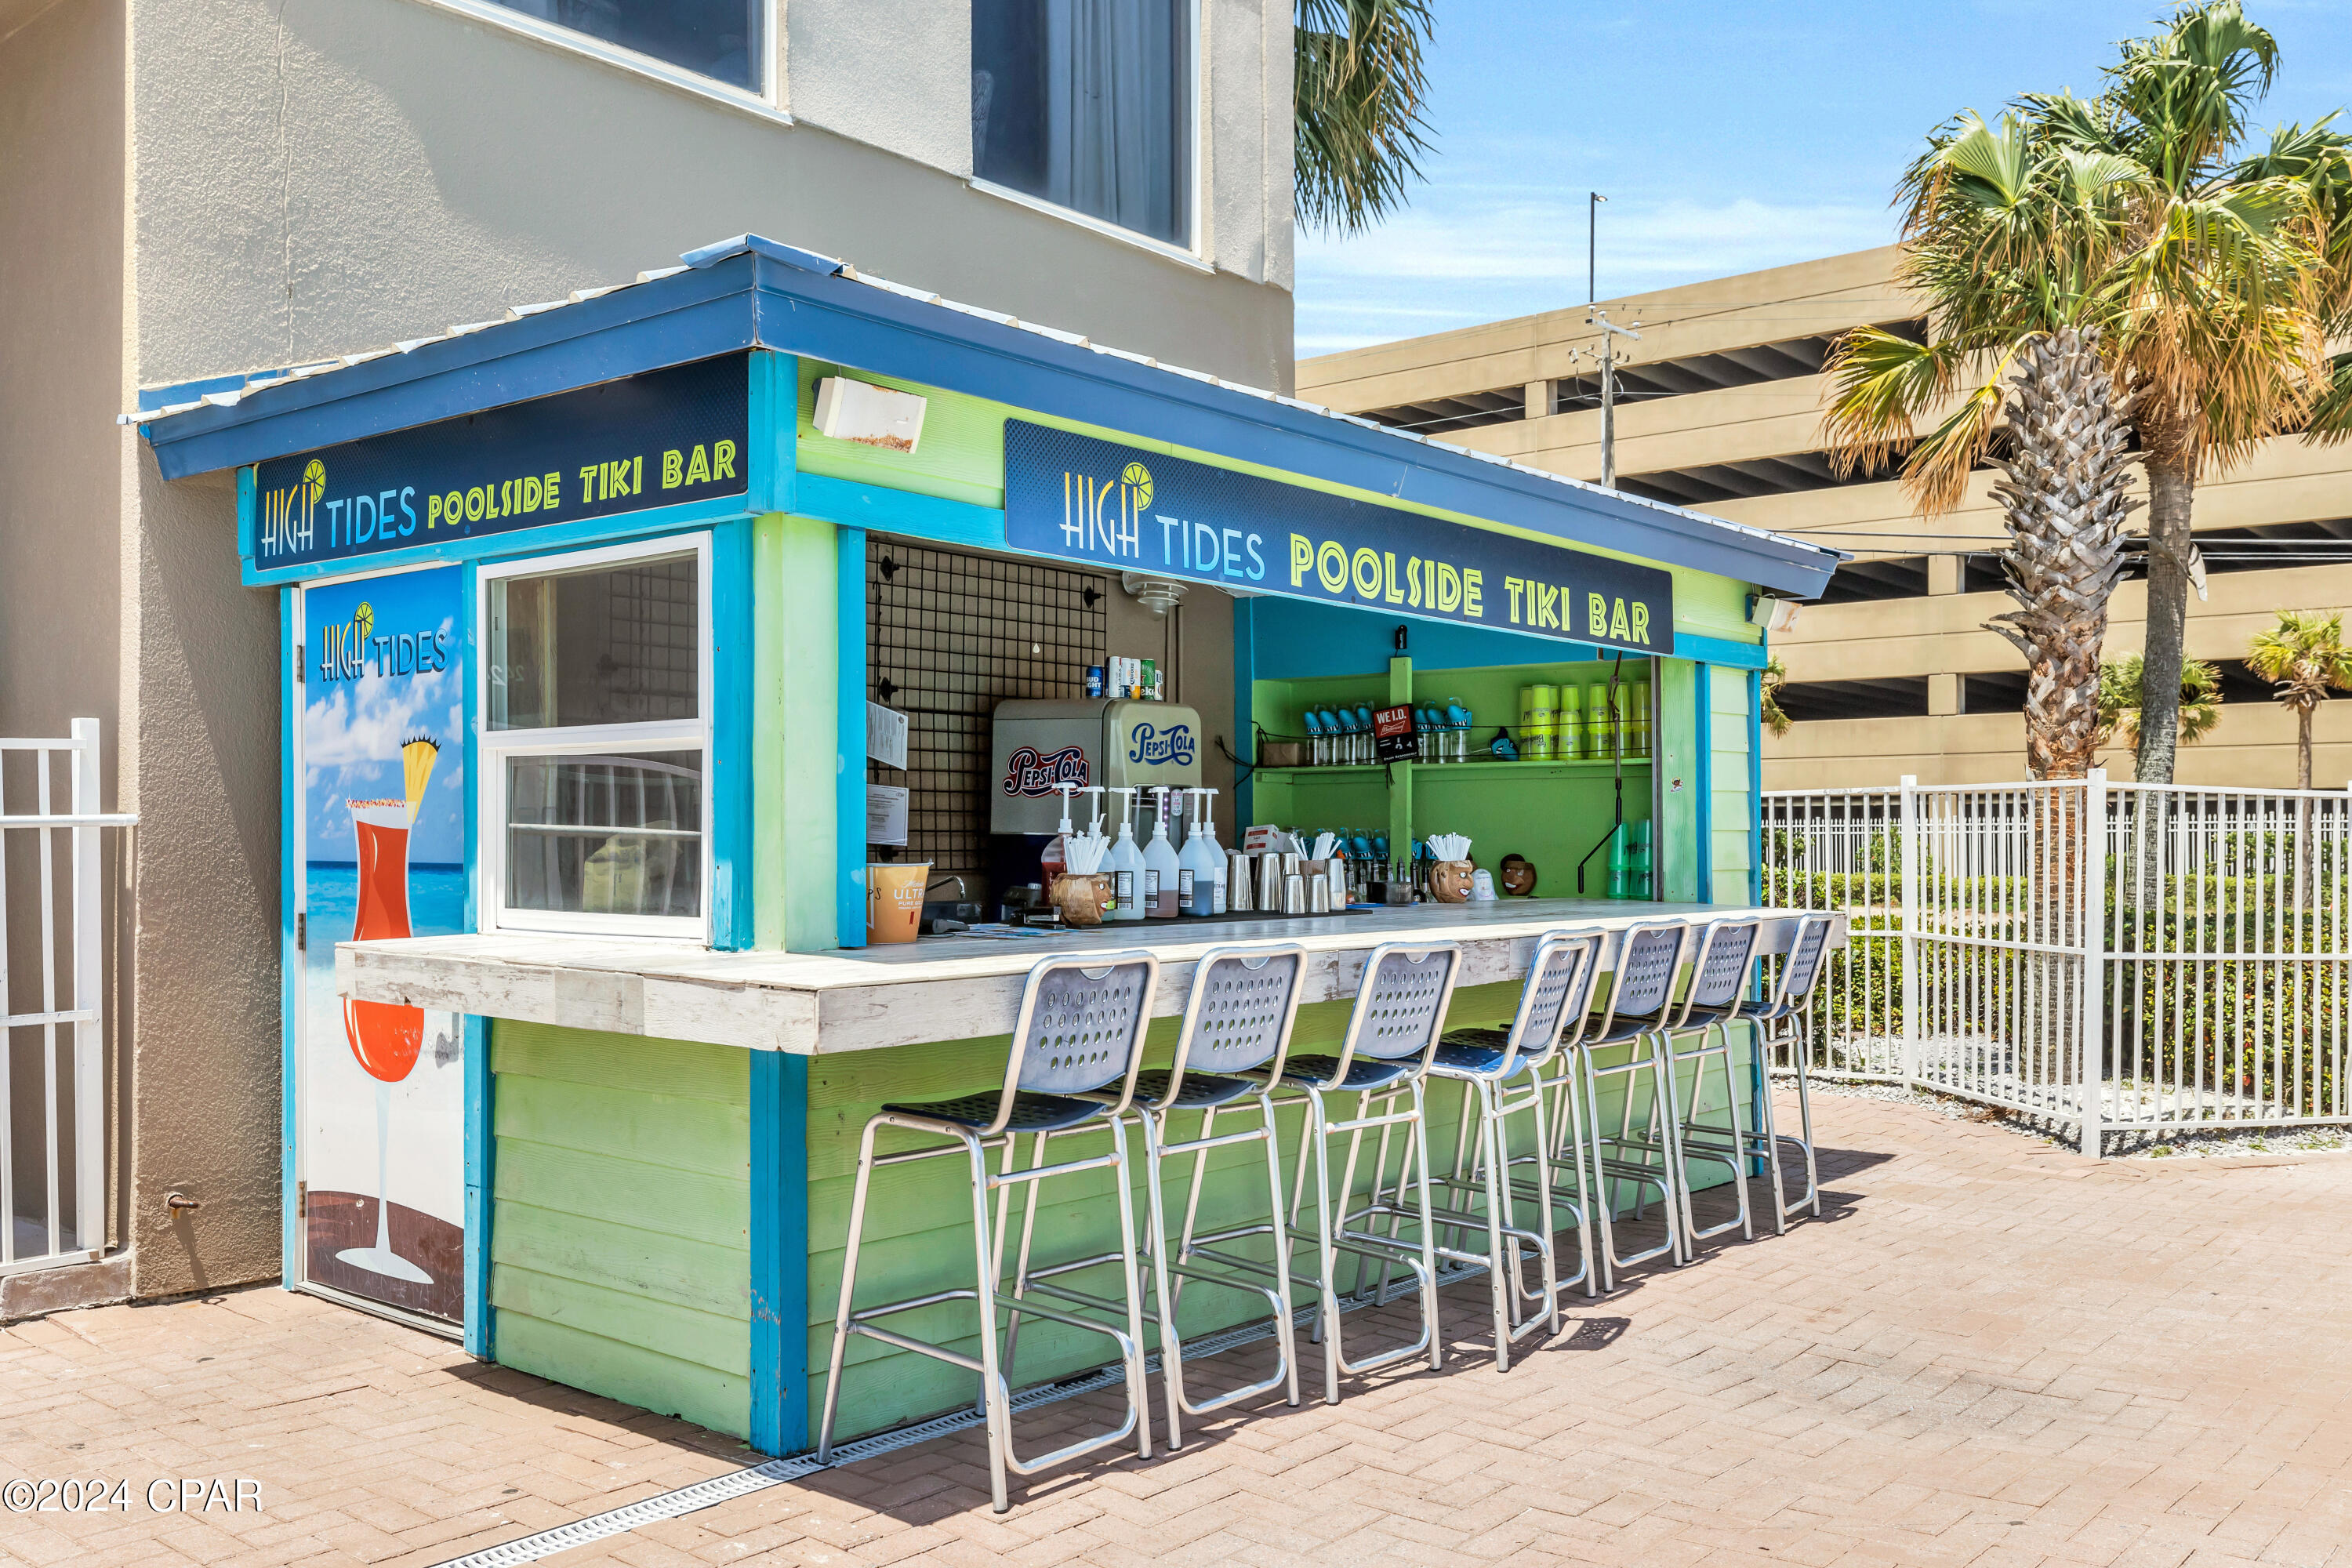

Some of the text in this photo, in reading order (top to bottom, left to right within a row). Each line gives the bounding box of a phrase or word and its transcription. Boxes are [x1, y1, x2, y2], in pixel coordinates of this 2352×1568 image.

[260, 439, 736, 557] HIGH TIDES POOLSIDE TIKI BAR
[1059, 472, 1650, 645] HIGH TIDES POOLSIDE TIKI BAR
[320, 620, 449, 682] HIGH TIDES
[1377, 709, 1406, 724] WE I.D.
